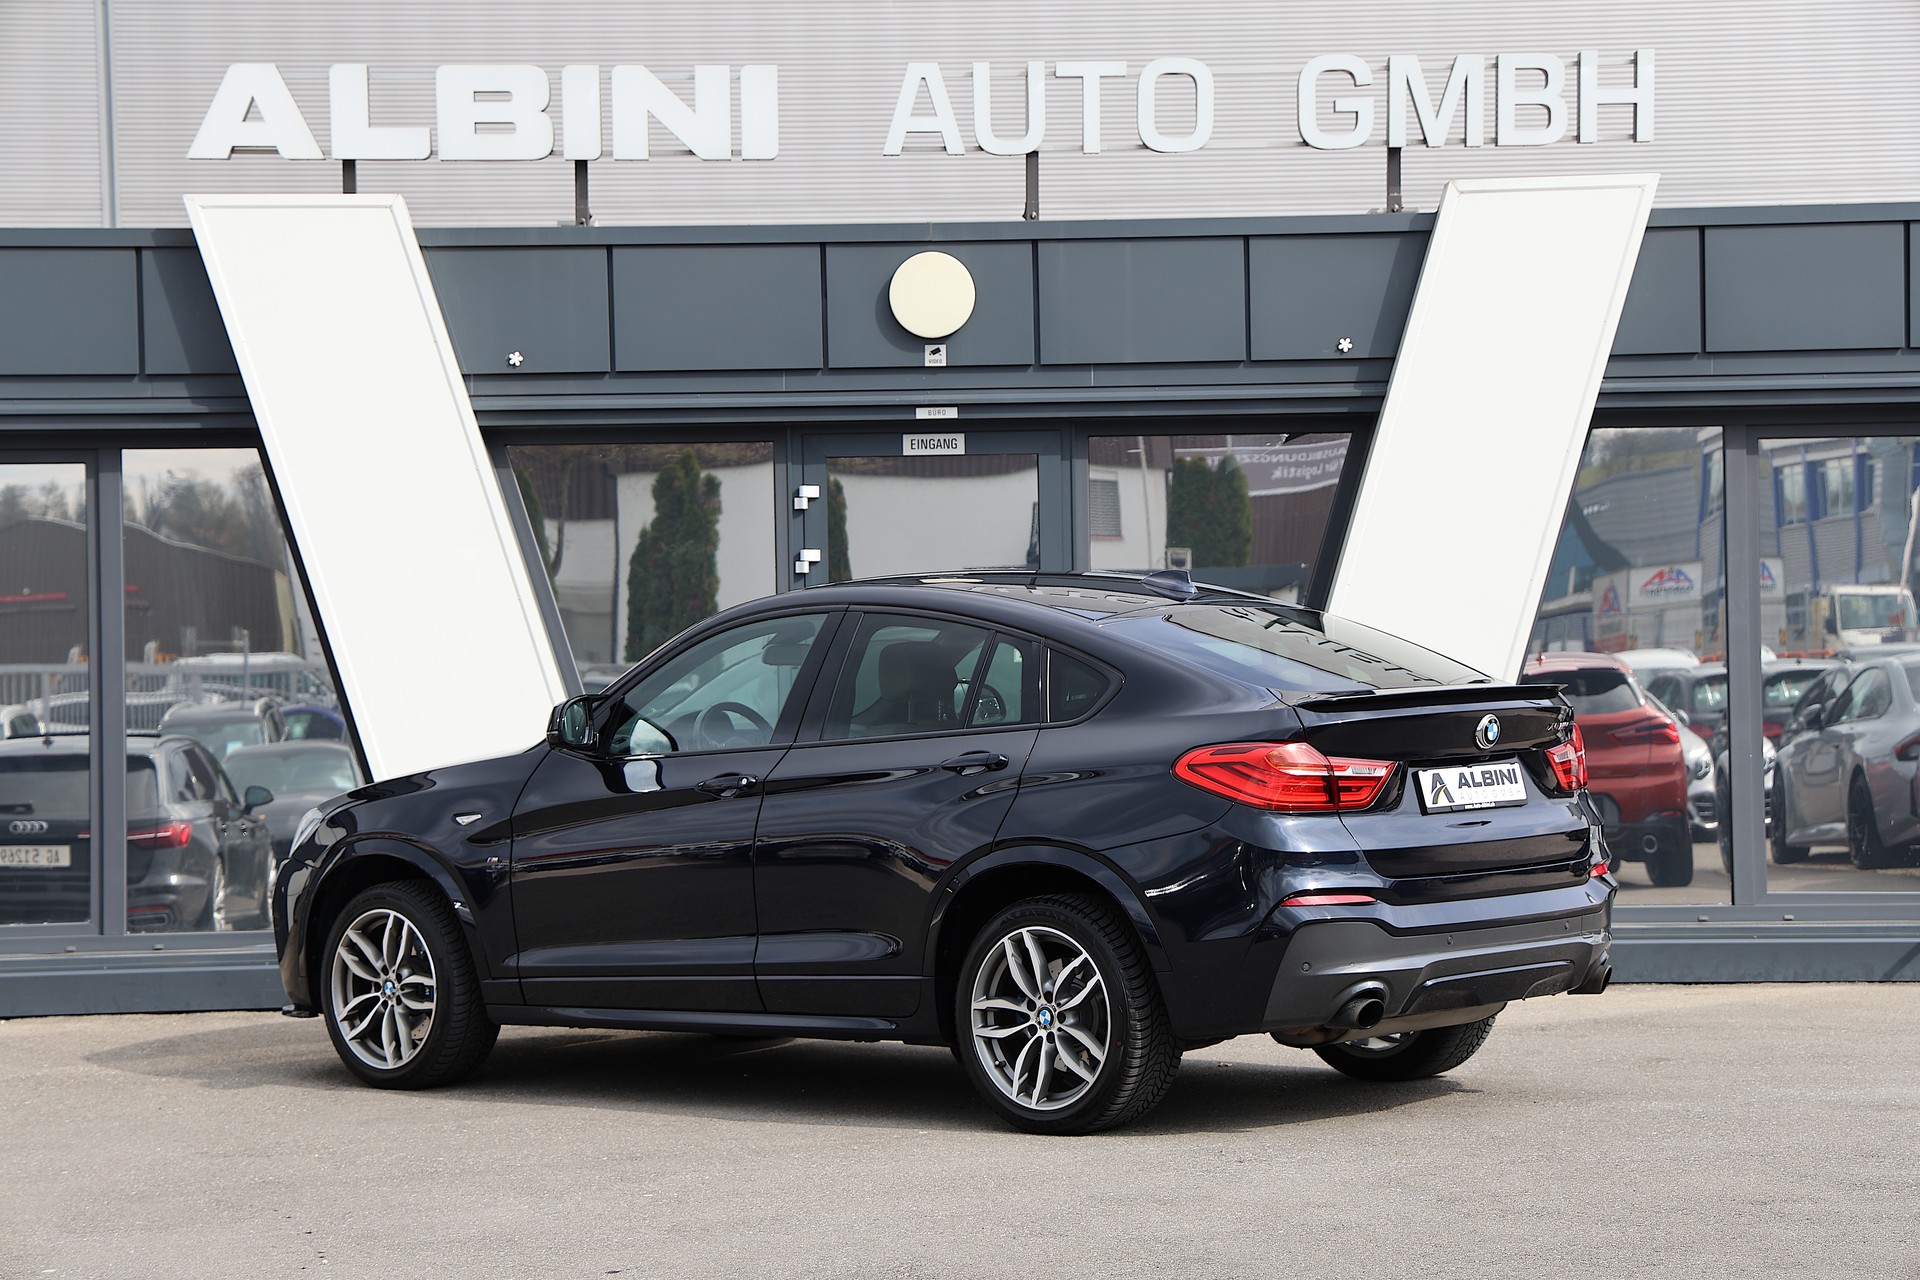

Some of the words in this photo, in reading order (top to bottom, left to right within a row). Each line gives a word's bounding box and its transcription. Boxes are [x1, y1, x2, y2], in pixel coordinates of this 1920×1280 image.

[187, 62, 779, 161] ALBINI
[883, 57, 1214, 156] AUTO
[1297, 48, 1656, 150] GMBH
[928, 407, 946, 416] BÜRO
[910, 438, 958, 450] EINGANG
[1458, 768, 1519, 789] ALBINI
